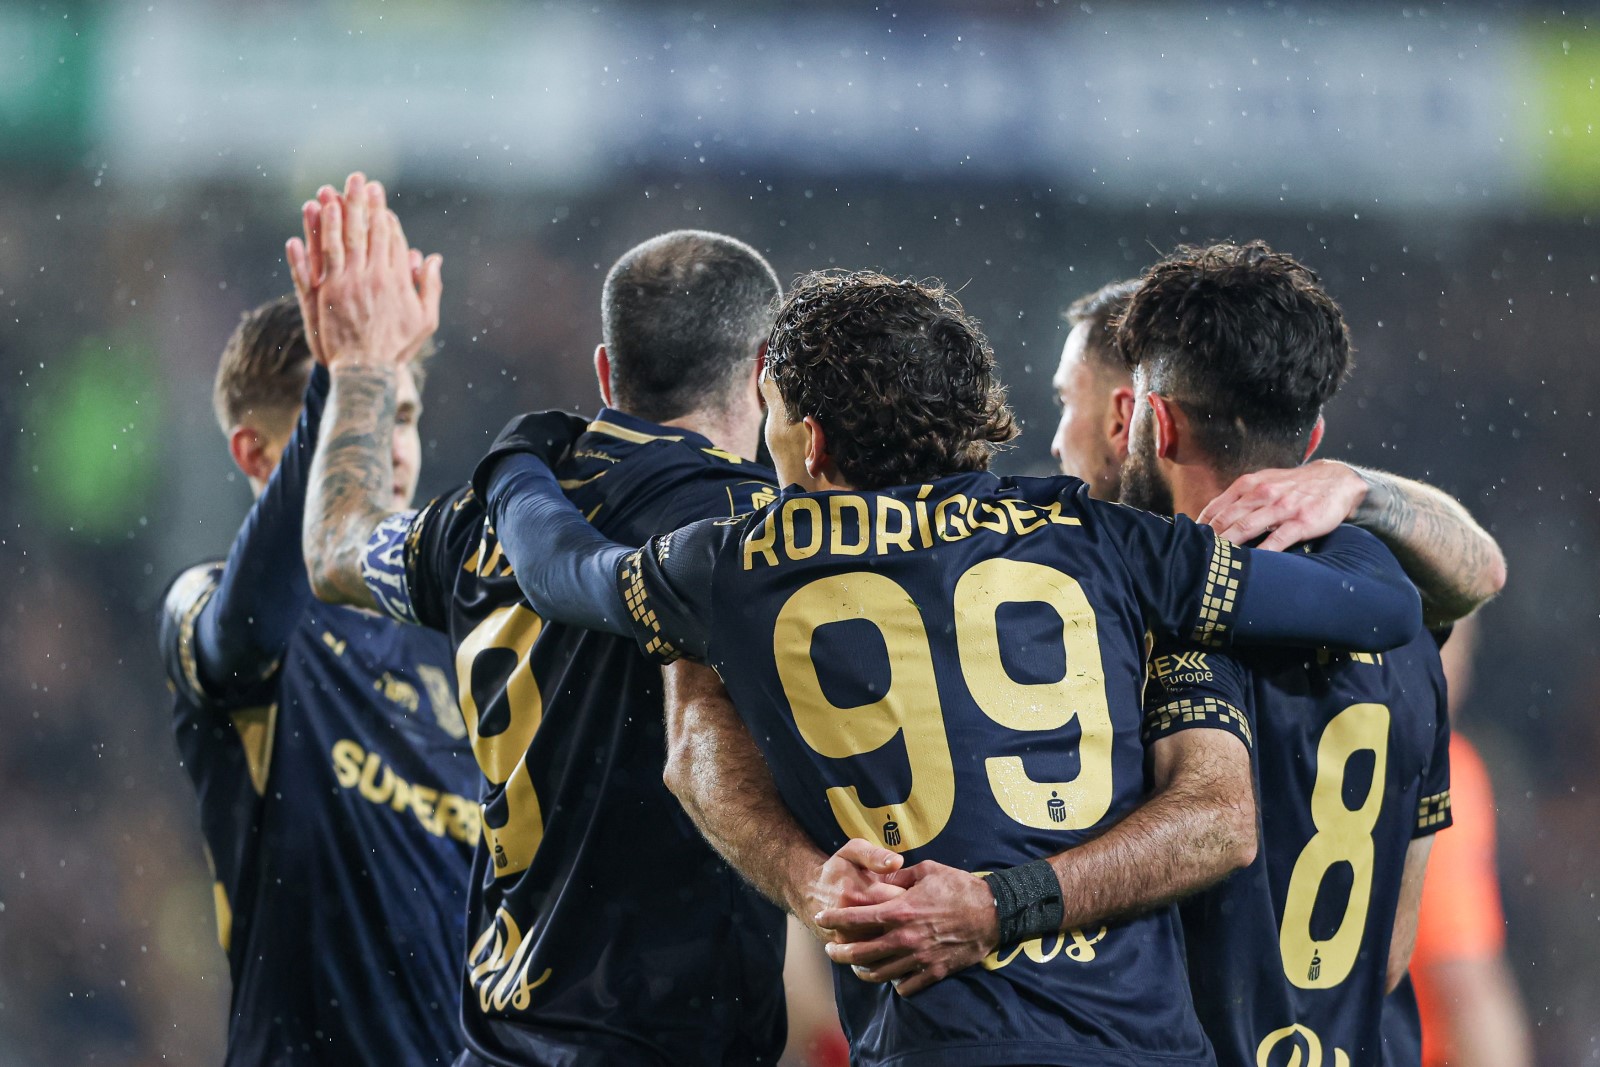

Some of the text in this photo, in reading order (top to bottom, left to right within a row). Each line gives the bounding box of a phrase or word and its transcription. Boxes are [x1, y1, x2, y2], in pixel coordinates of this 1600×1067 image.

[743, 484, 1081, 571] RODRÍGUEZ
[455, 602, 543, 878] 9
[773, 557, 1113, 853] 99
[1160, 671, 1213, 688] Europe
[1279, 702, 1391, 990] 8
